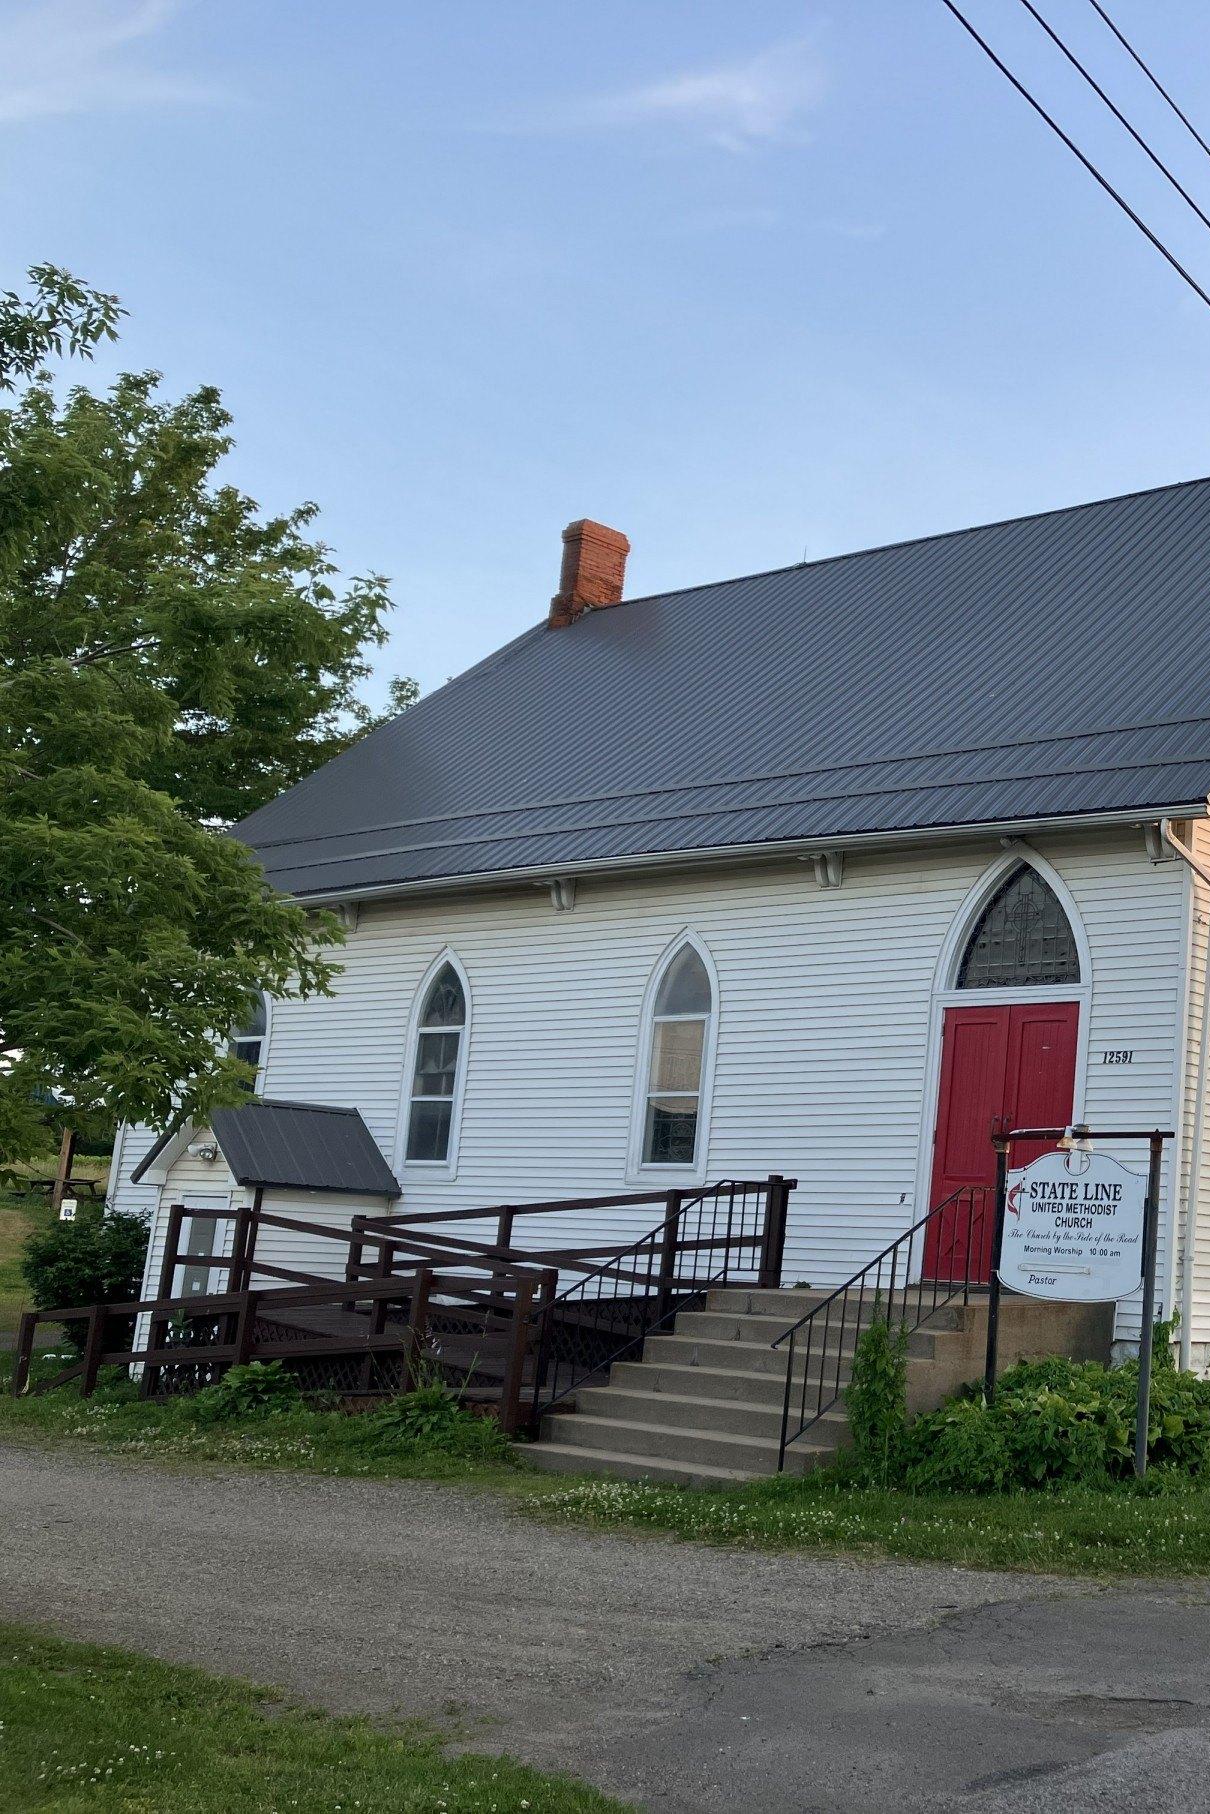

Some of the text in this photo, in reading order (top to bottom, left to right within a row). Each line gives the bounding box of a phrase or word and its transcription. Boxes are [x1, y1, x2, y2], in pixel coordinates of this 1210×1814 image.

[1102, 1050, 1133, 1064] 12591
[1030, 1181, 1122, 1201] STATE LINE
[1031, 1202, 1118, 1216] UNITED METHODIST
[1055, 1216, 1093, 1229] CHURCH
[1008, 1228, 1139, 1245] The Church by the Side of the Road
[1023, 1245, 1052, 1255] Morning
[1054, 1246, 1083, 1257] Worship
[1028, 1274, 1057, 1286] Pastor
